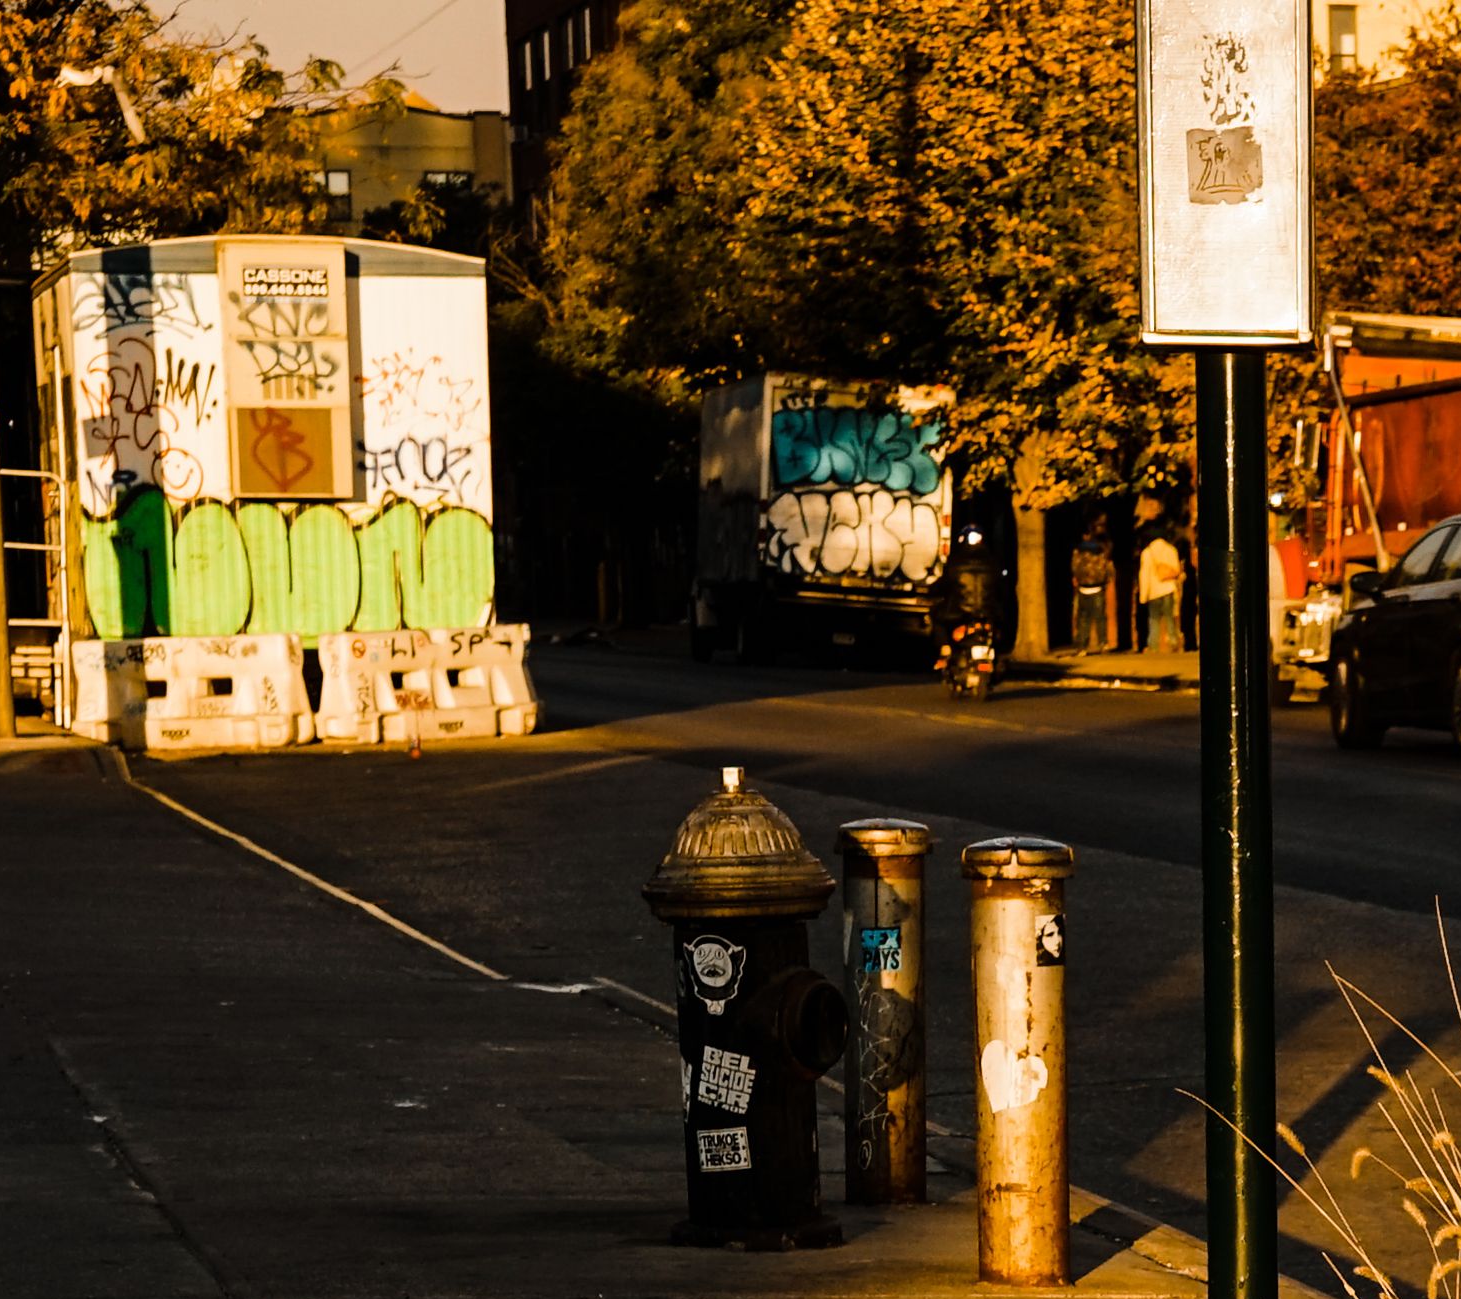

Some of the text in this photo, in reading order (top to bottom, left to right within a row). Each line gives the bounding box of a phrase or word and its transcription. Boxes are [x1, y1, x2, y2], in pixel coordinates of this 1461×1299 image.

[243, 269, 327, 283] CASSONE
[862, 949, 901, 970] PAYS
[703, 1045, 757, 1075] BEL
